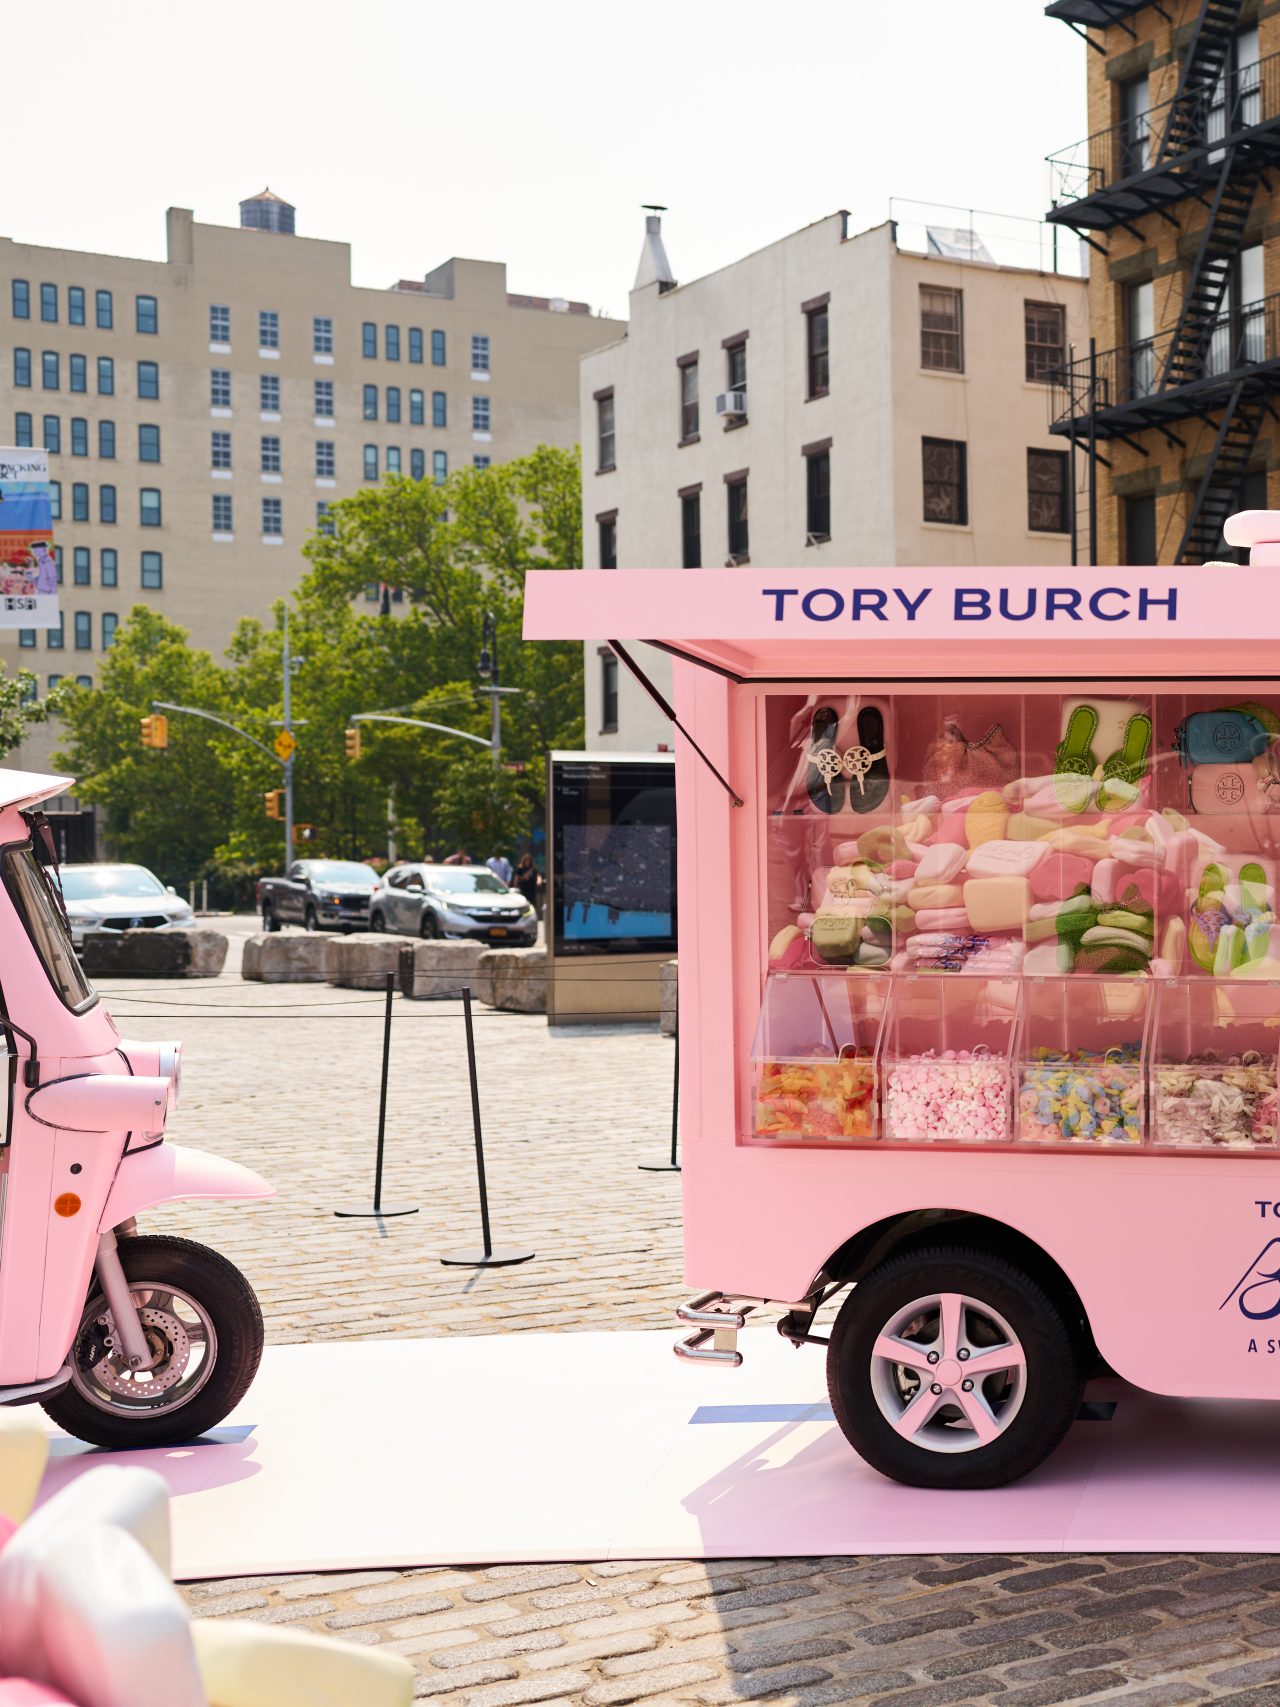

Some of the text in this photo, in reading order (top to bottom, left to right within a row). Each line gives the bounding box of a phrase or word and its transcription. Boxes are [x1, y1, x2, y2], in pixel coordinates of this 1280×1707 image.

[762, 587, 1177, 621] TORY BURCH
[1248, 1339, 1257, 1353] A
